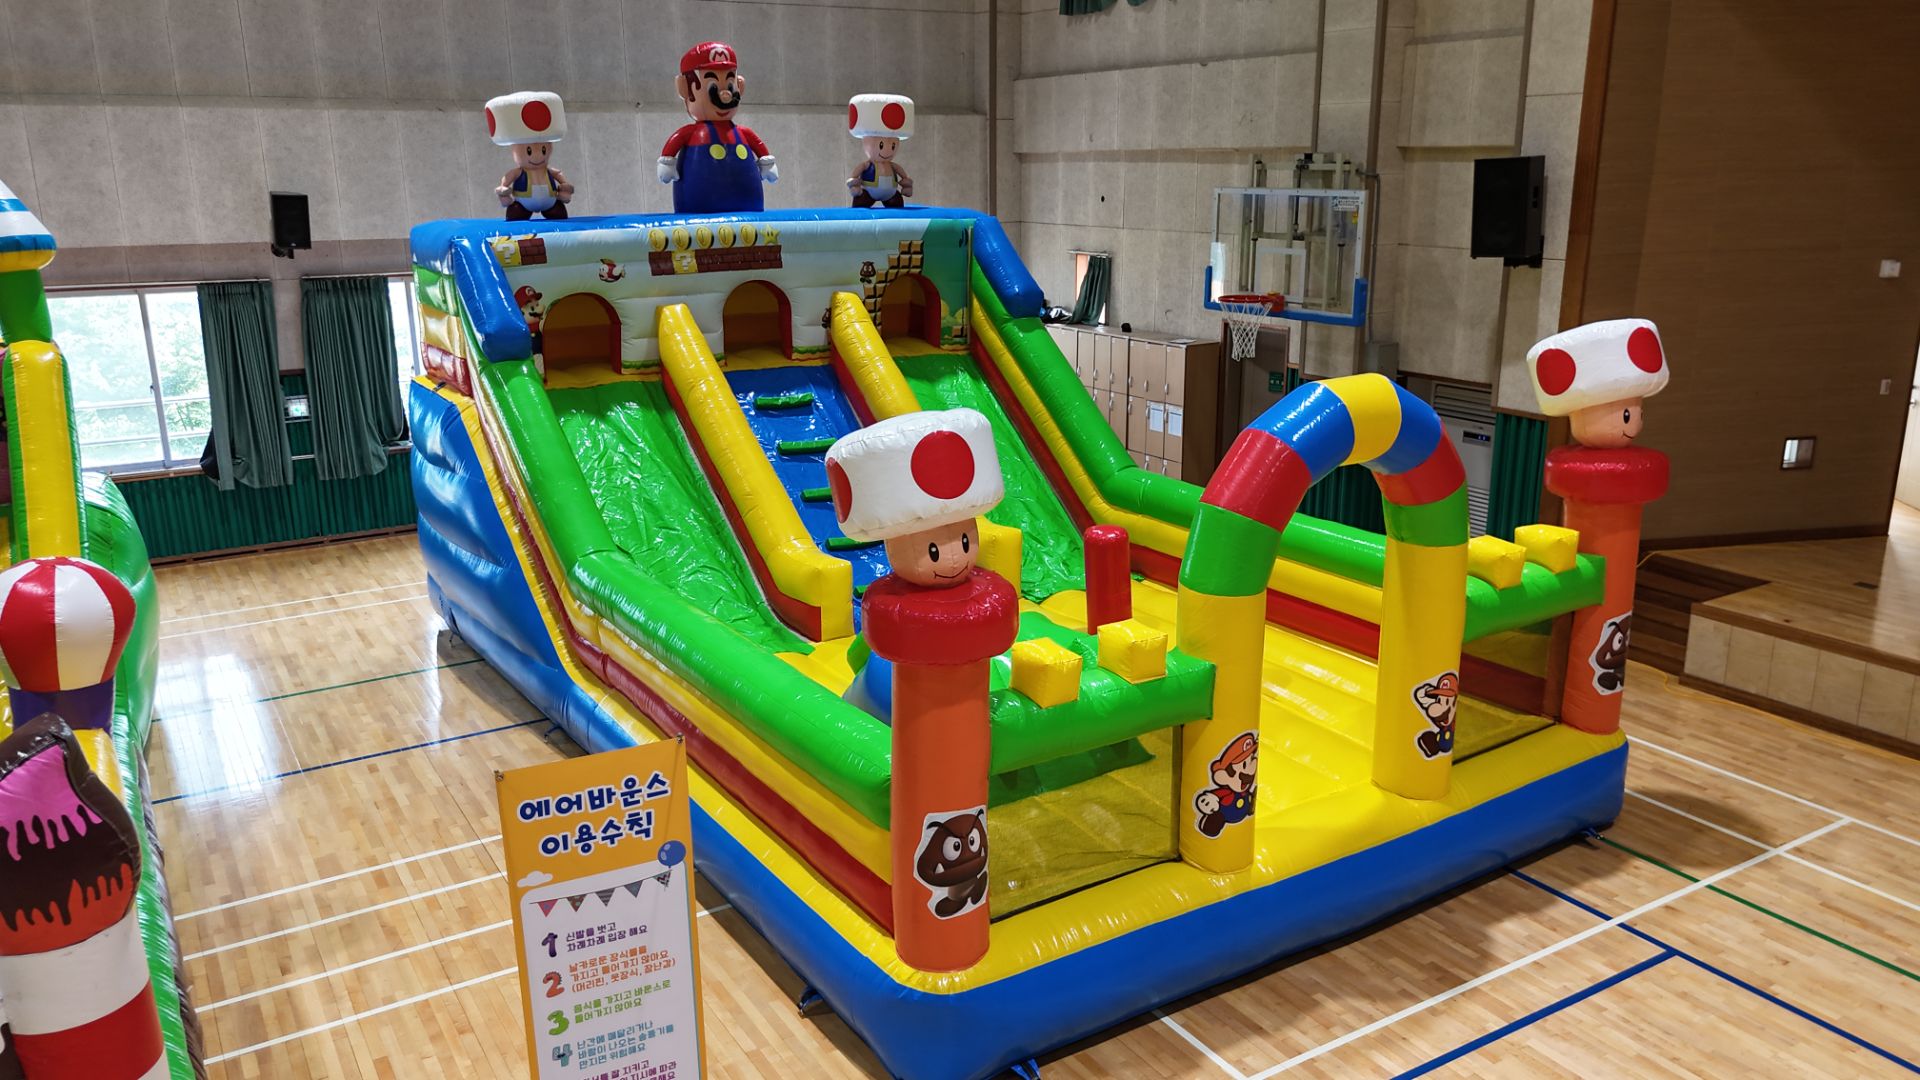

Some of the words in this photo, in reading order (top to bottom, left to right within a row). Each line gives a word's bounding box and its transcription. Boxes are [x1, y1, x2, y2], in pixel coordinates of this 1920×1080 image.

[519, 773, 669, 820] 에어바운스
[541, 811, 653, 855] 이용수칙
[597, 922, 616, 935] 벗고
[541, 932, 558, 958] 1
[567, 935, 606, 952] 차례차례
[608, 930, 627, 943] 입장
[569, 955, 608, 973] 날카로운
[571, 968, 599, 982] 가지고
[641, 950, 669, 964] 않아요
[542, 971, 565, 998] 2
[604, 990, 632, 1004] 가지고
[634, 980, 671, 997] 바운스로
[614, 998, 642, 1013] 않아요
[547, 1009, 570, 1036] 3
[577, 1034, 605, 1050] 난간에
[578, 1045, 606, 1059] 바람이
[608, 1037, 636, 1051] 나오는
[552, 1043, 573, 1067] 4
[579, 1055, 607, 1070] 만지면
[623, 1060, 649, 1076] 지키고
[659, 1060, 677, 1074] 따라
